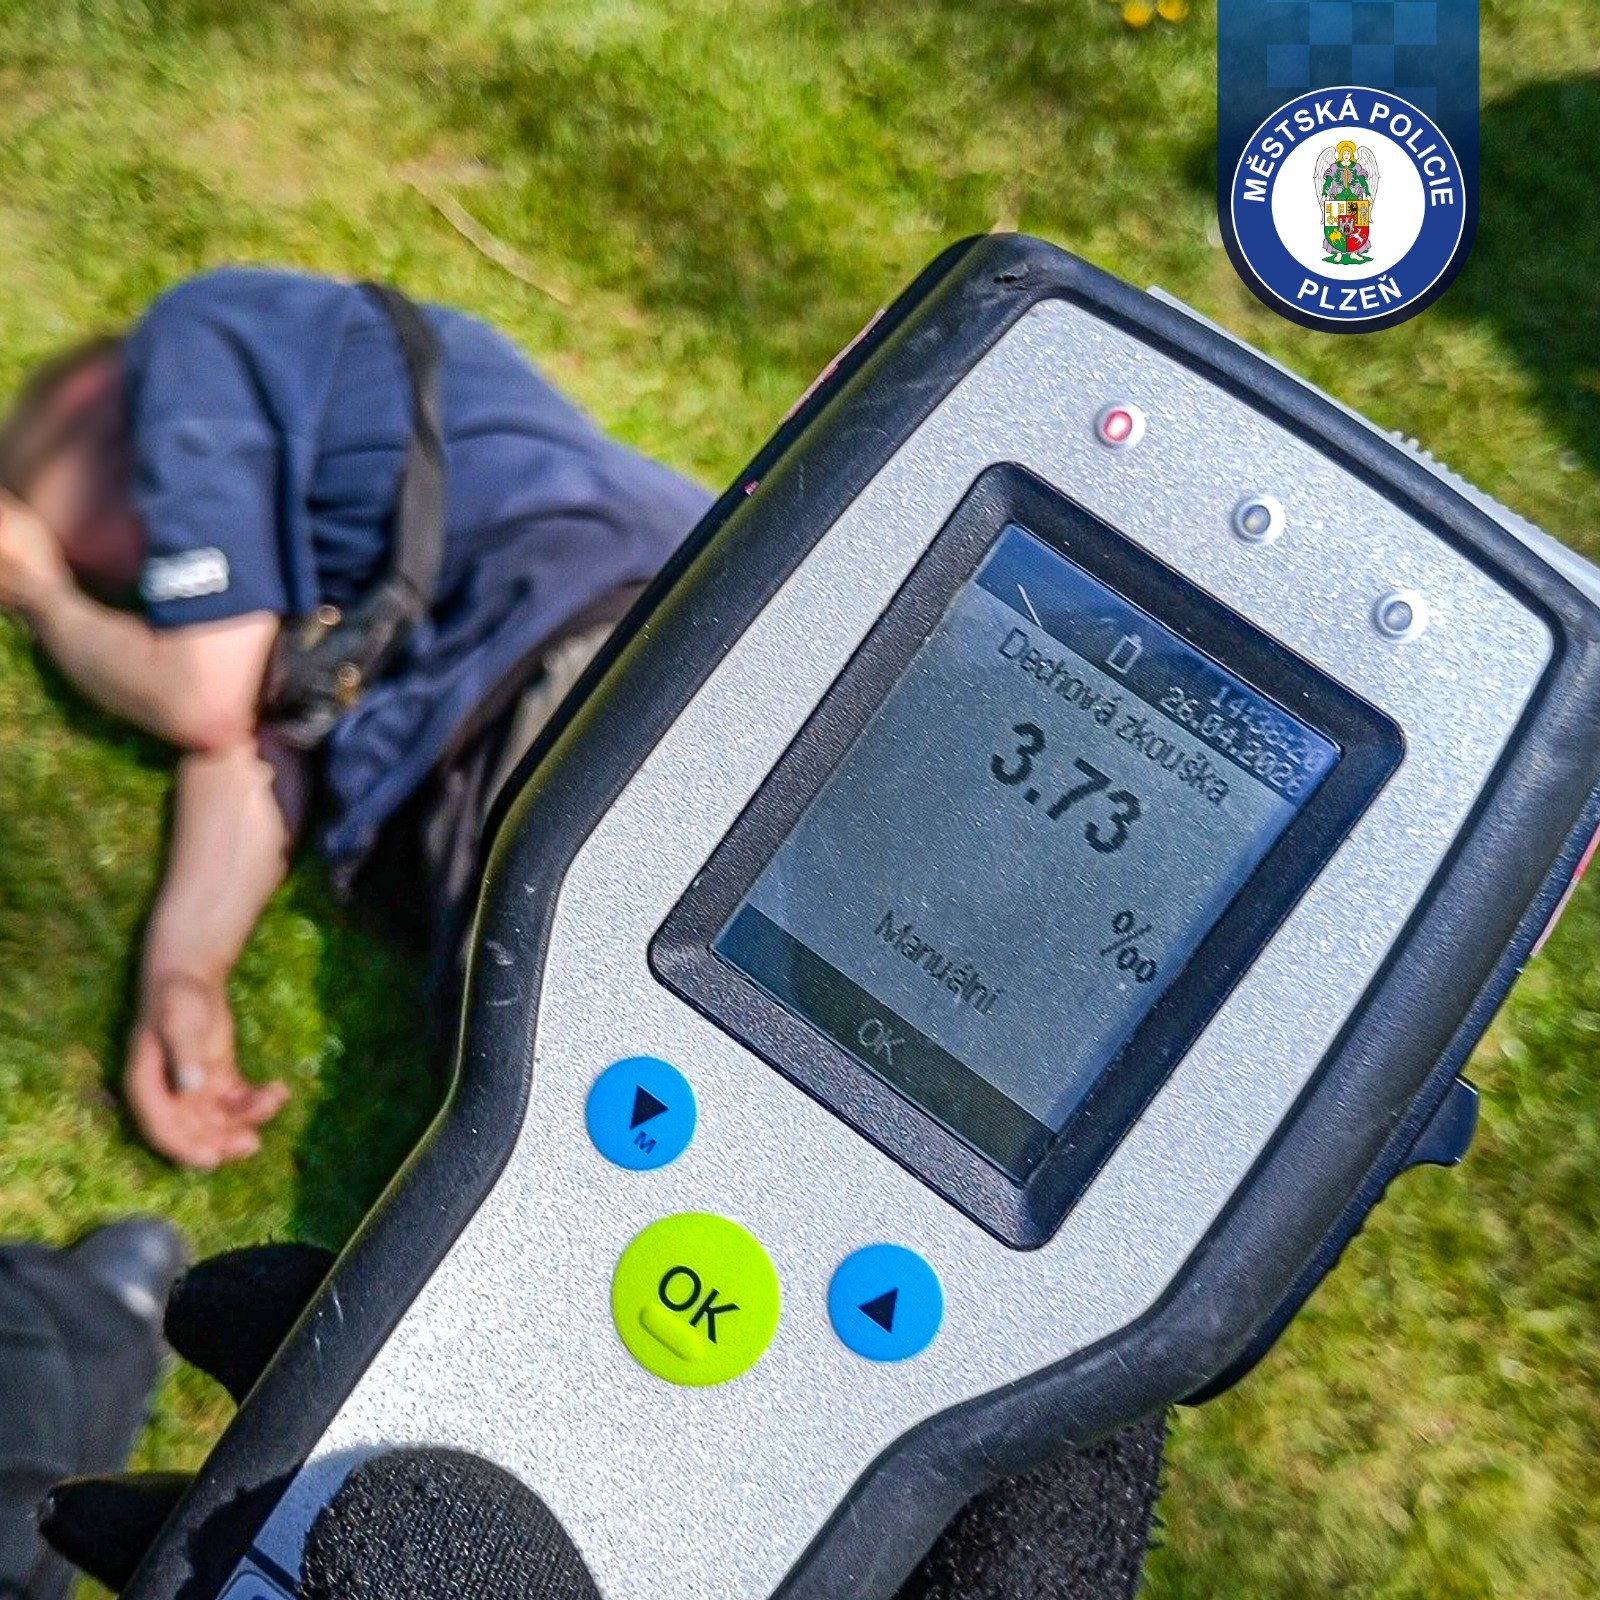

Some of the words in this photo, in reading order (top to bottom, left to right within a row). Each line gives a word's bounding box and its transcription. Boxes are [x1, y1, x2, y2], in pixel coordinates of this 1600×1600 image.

[999, 627, 1124, 728] Dechová
[1115, 711, 1231, 803] zkouška
[990, 721, 1143, 855] 3.73
[873, 909, 1006, 1016] Manuální
[856, 1016, 906, 1066] OK
[632, 1131, 657, 1156] M
[657, 1264, 741, 1345] OK
